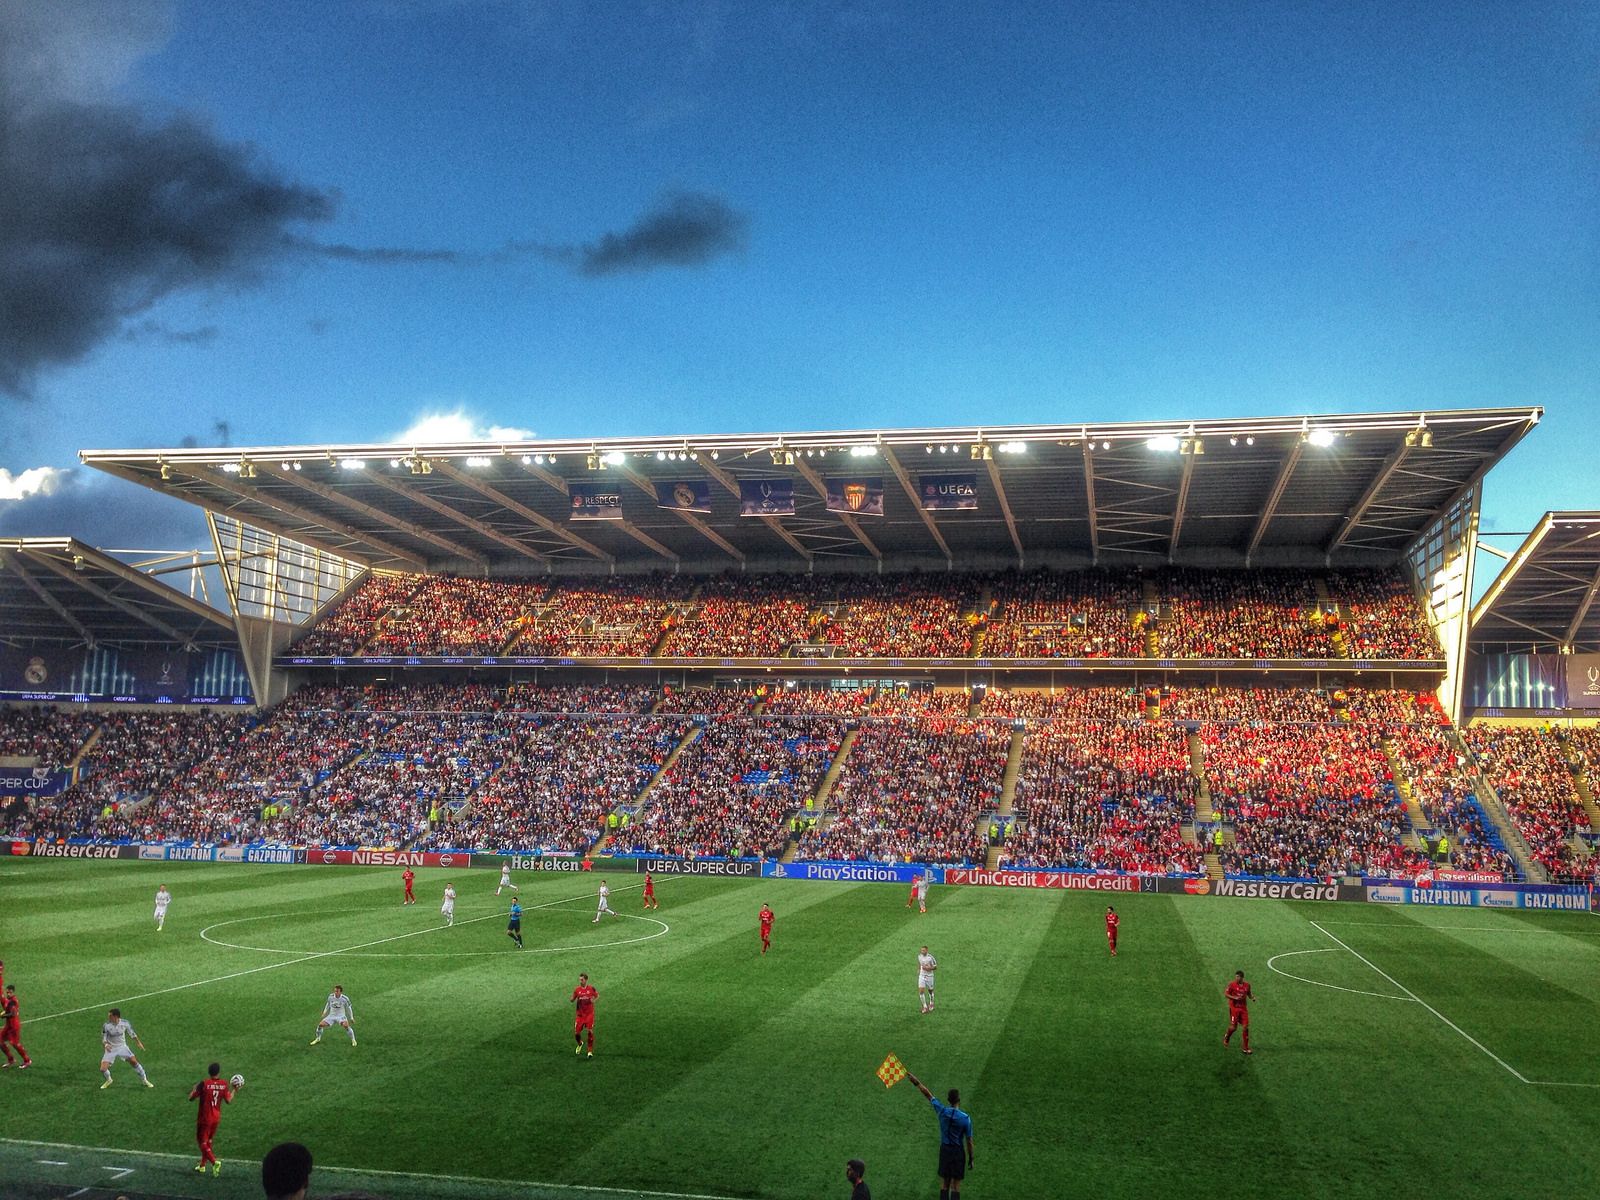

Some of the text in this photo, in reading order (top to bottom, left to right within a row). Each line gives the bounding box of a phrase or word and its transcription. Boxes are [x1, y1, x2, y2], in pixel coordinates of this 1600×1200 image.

[938, 485, 973, 495] UEFA
[586, 496, 620, 505] RESPECT
[24, 779, 49, 788] CUP
[33, 843, 120, 858] MasterCard
[170, 848, 211, 859] GAZPROM
[248, 850, 291, 862] GAZPROM
[352, 852, 423, 865] NISSAN
[647, 860, 752, 874] UEFA SUPER CUP
[808, 865, 897, 880] PlayStation
[968, 870, 1037, 887] UniCredit
[1062, 873, 1132, 890] UniCredit
[1216, 880, 1338, 900] MasterCard
[1412, 889, 1471, 904] GAZPROM
[1525, 894, 1585, 909] GAZPROM
